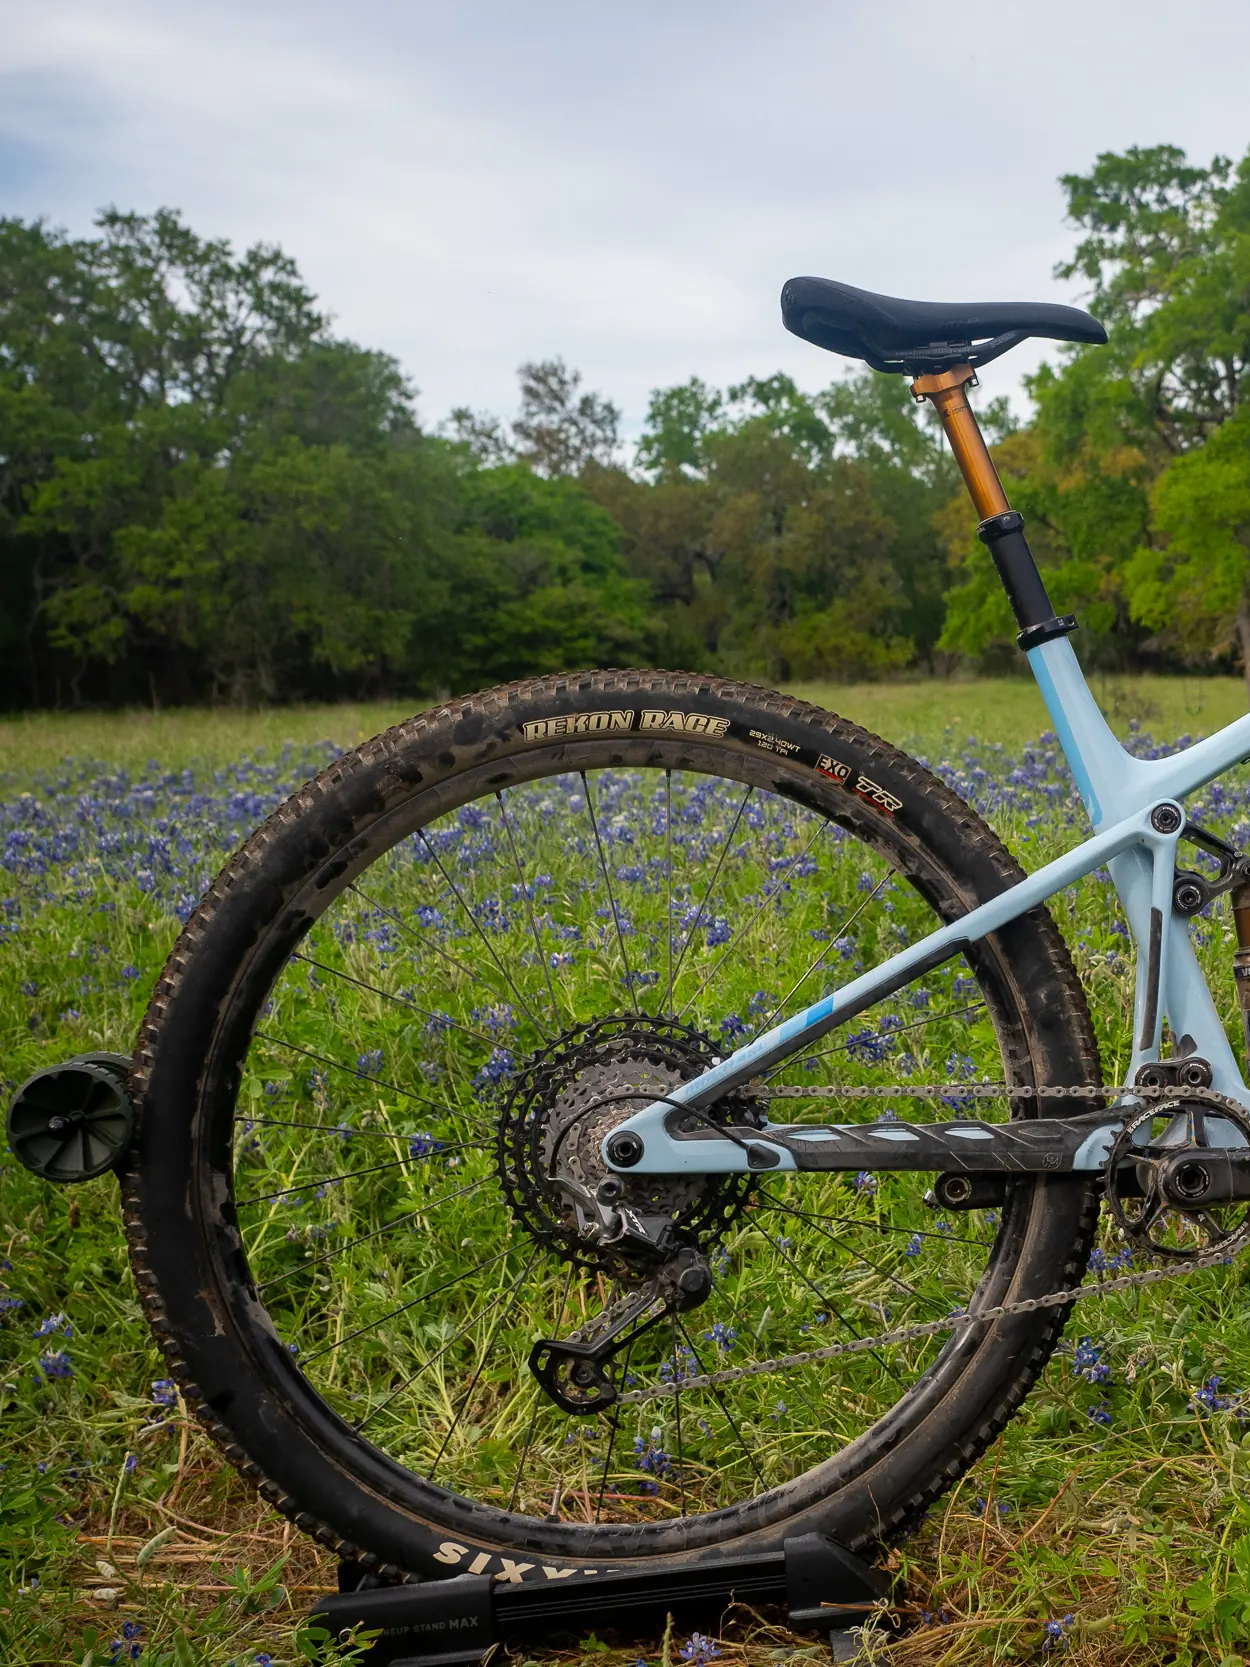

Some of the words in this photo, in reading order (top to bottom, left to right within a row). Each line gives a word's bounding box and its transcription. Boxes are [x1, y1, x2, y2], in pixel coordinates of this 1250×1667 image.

[524, 710, 633, 742] REKON
[640, 710, 730, 738] RACE
[757, 740, 773, 750] 120
[776, 745, 788, 755] TPI
[820, 757, 849, 779] EXO
[856, 776, 903, 812] TR
[1132, 1100, 1180, 1130] RACEFACE
[625, 1208, 646, 1234] XTR
[383, 1626, 410, 1636] NEUP
[413, 1621, 446, 1633] STAND
[449, 1615, 479, 1630] MAX
